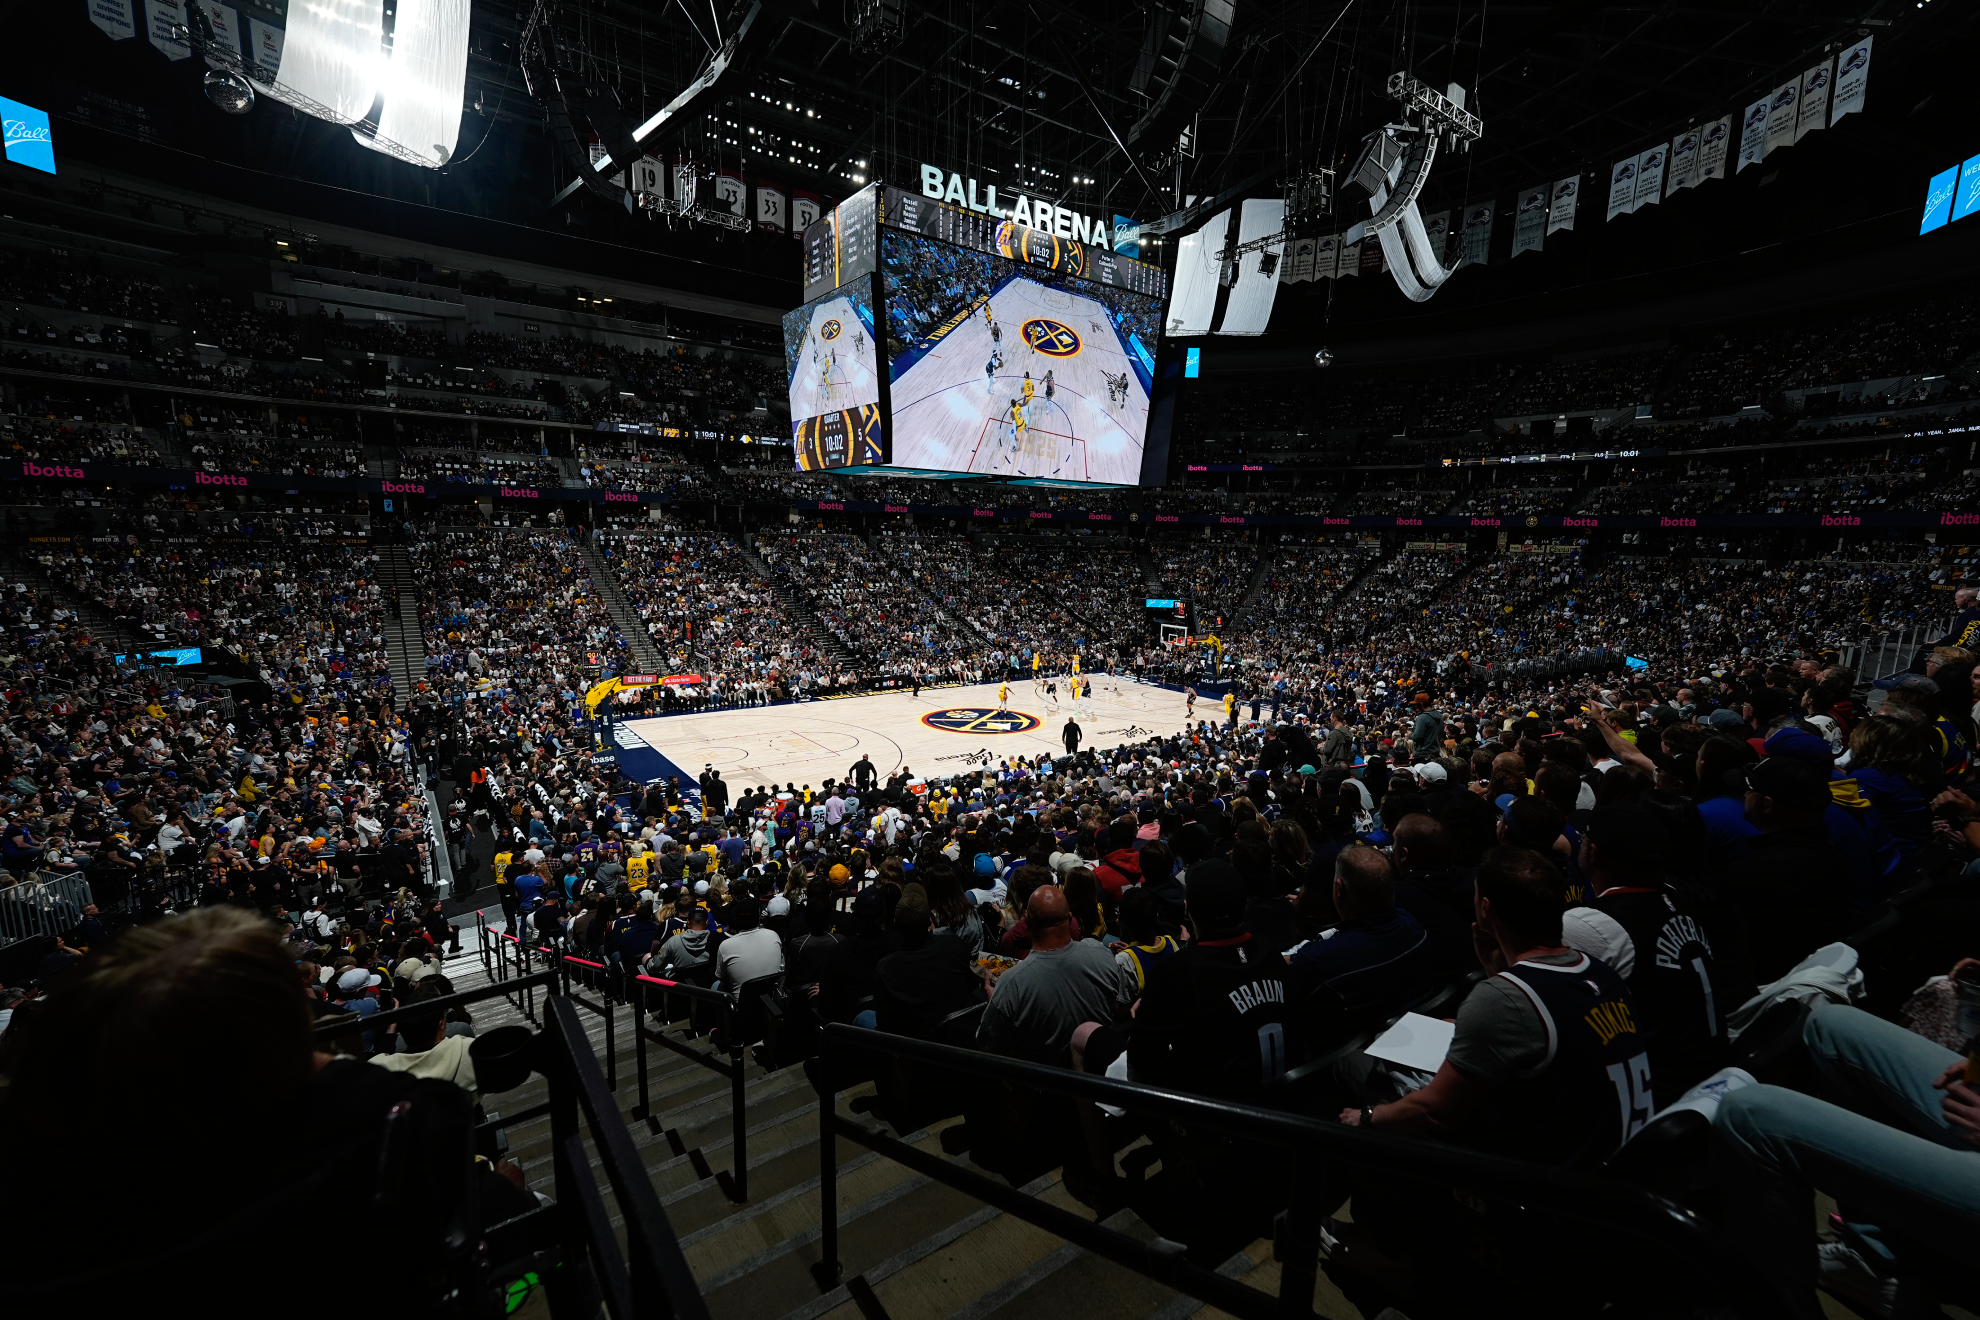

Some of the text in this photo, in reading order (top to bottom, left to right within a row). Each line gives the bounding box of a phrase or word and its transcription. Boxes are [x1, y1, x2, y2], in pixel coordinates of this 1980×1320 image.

[97, 3, 125, 18] DIVISION
[93, 10, 131, 29] CHAMPIONS
[4, 119, 51, 143] Ball
[725, 188, 739, 207] 23
[764, 199, 778, 217] 33
[921, 163, 1006, 220] BALL
[1012, 195, 1109, 250] ARENA
[801, 210, 813, 228] 52
[1115, 221, 1141, 246] Ball
[1014, 239, 1018, 248] 3
[50, 248, 68, 257] 334
[1032, 245, 1050, 259] 10:02
[1063, 253, 1068, 262] 5
[824, 412, 840, 424] QUARTER
[702, 431, 717, 439] 10:01
[857, 428, 863, 441] 5
[809, 437, 813, 449] 3
[825, 434, 844, 452] 10:02
[23, 462, 84, 478] ibotta
[195, 471, 247, 485] ibotta
[382, 480, 425, 493] ibotta
[501, 486, 539, 498] ibotta
[605, 491, 639, 502] ibotta
[818, 500, 844, 511] ibotta
[885, 504, 908, 512] ibotta
[974, 508, 994, 517] ibotta
[1030, 510, 1052, 519] ibotta
[1089, 512, 1112, 521] ibotta
[1155, 514, 1179, 522] ibotta
[1941, 511, 1980, 525] ibotta
[1220, 516, 1245, 524] ibotta
[1324, 517, 1349, 525] ibotta
[1396, 517, 1422, 525] ibotta
[1471, 517, 1500, 526] ibotta
[1563, 517, 1598, 527] ibotta
[1660, 516, 1697, 527] ibotta
[1821, 514, 1861, 526] ibotta
[813, 813, 825, 823] 25
[581, 852, 594, 862] 24
[631, 868, 645, 879] 23
[580, 879, 597, 895] 15
[857, 880, 875, 893] 15
[1655, 914, 1698, 970] PORTER
[1228, 979, 1284, 1015] BRAUN
[1690, 957, 1718, 1037] 1
[1584, 998, 1637, 1047] JOKIĆ
[1257, 1022, 1286, 1083] 0
[1605, 1051, 1656, 1148] 15
